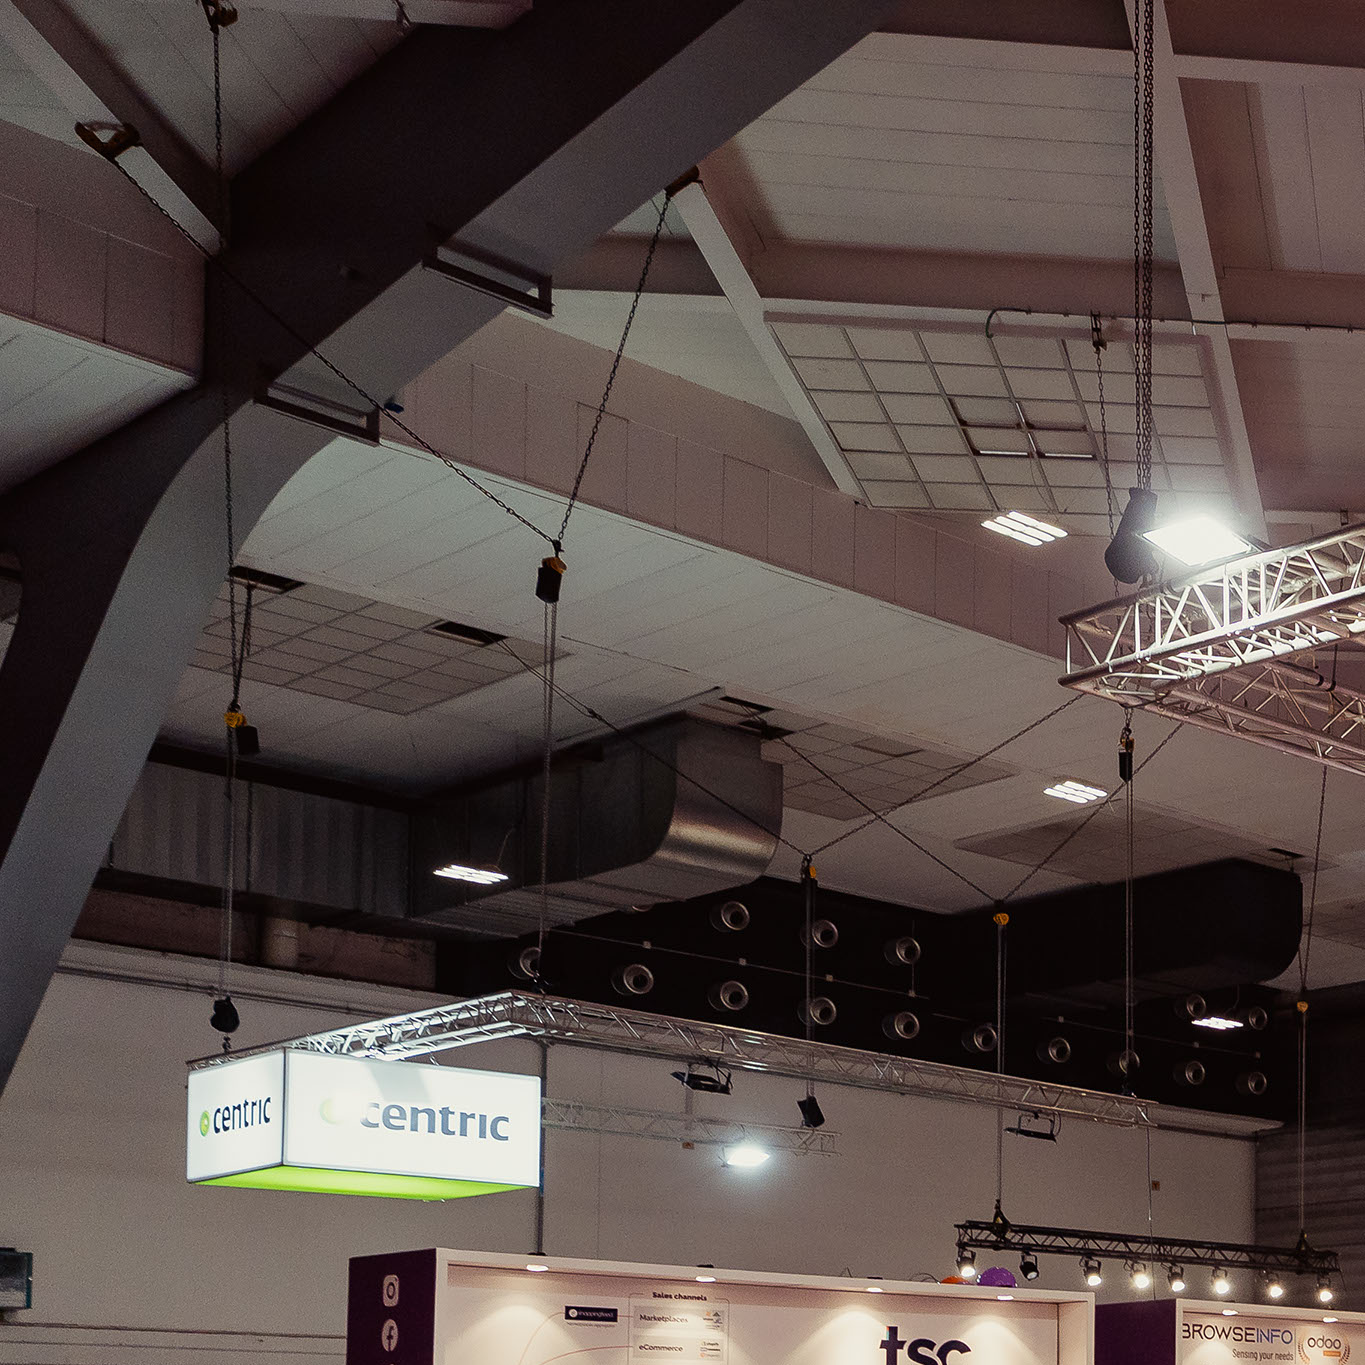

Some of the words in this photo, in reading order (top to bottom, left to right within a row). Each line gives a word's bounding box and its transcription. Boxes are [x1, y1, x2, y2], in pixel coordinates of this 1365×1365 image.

[213, 1096, 272, 1134] centric
[359, 1102, 511, 1142] centric
[652, 1291, 673, 1300] Sales
[674, 1293, 708, 1302] channels
[639, 1314, 689, 1324] Marketplaces
[1182, 1323, 1294, 1344] BROWSEINFO
[638, 1344, 684, 1352] eCommerce
[1307, 1335, 1342, 1350] odoo
[1232, 1348, 1258, 1361] Sensing
[1258, 1352, 1273, 1362] your
[1273, 1351, 1294, 1361] needs
